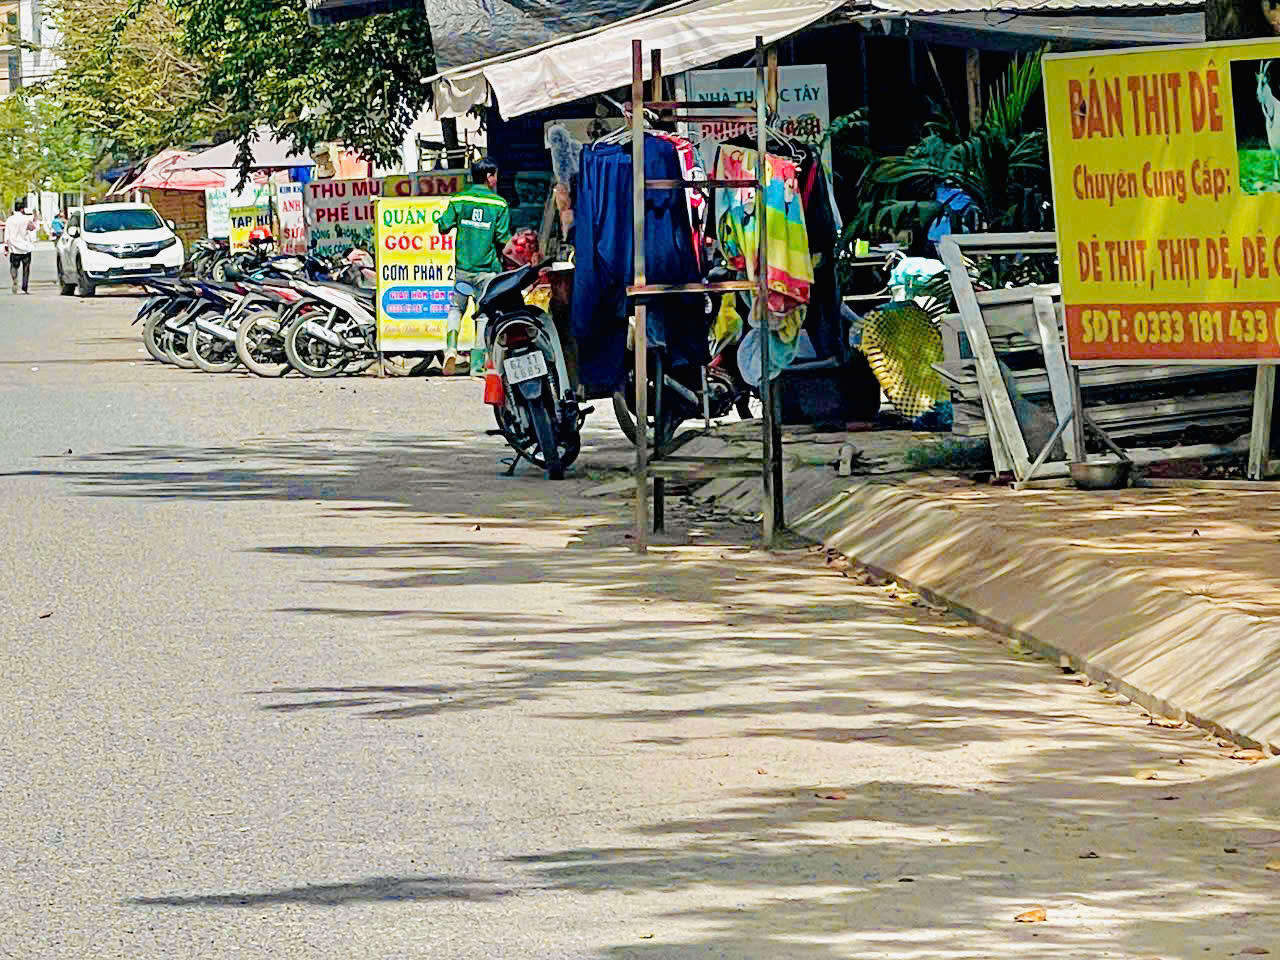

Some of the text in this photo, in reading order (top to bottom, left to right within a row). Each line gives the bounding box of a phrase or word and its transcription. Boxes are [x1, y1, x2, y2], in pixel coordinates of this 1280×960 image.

[734, 88, 790, 102] THC
[793, 83, 820, 101] TÂY
[1068, 59, 1223, 144] BÁN THỊT DÊ
[310, 181, 380, 199] THU MU
[1142, 161, 1186, 203] Cung
[383, 205, 426, 227] QUÁN
[385, 231, 423, 250] GÓC
[429, 235, 454, 250] PH
[382, 264, 409, 281] CƠM
[1135, 310, 1185, 344] 0333
[1229, 309, 1269, 344] 433
